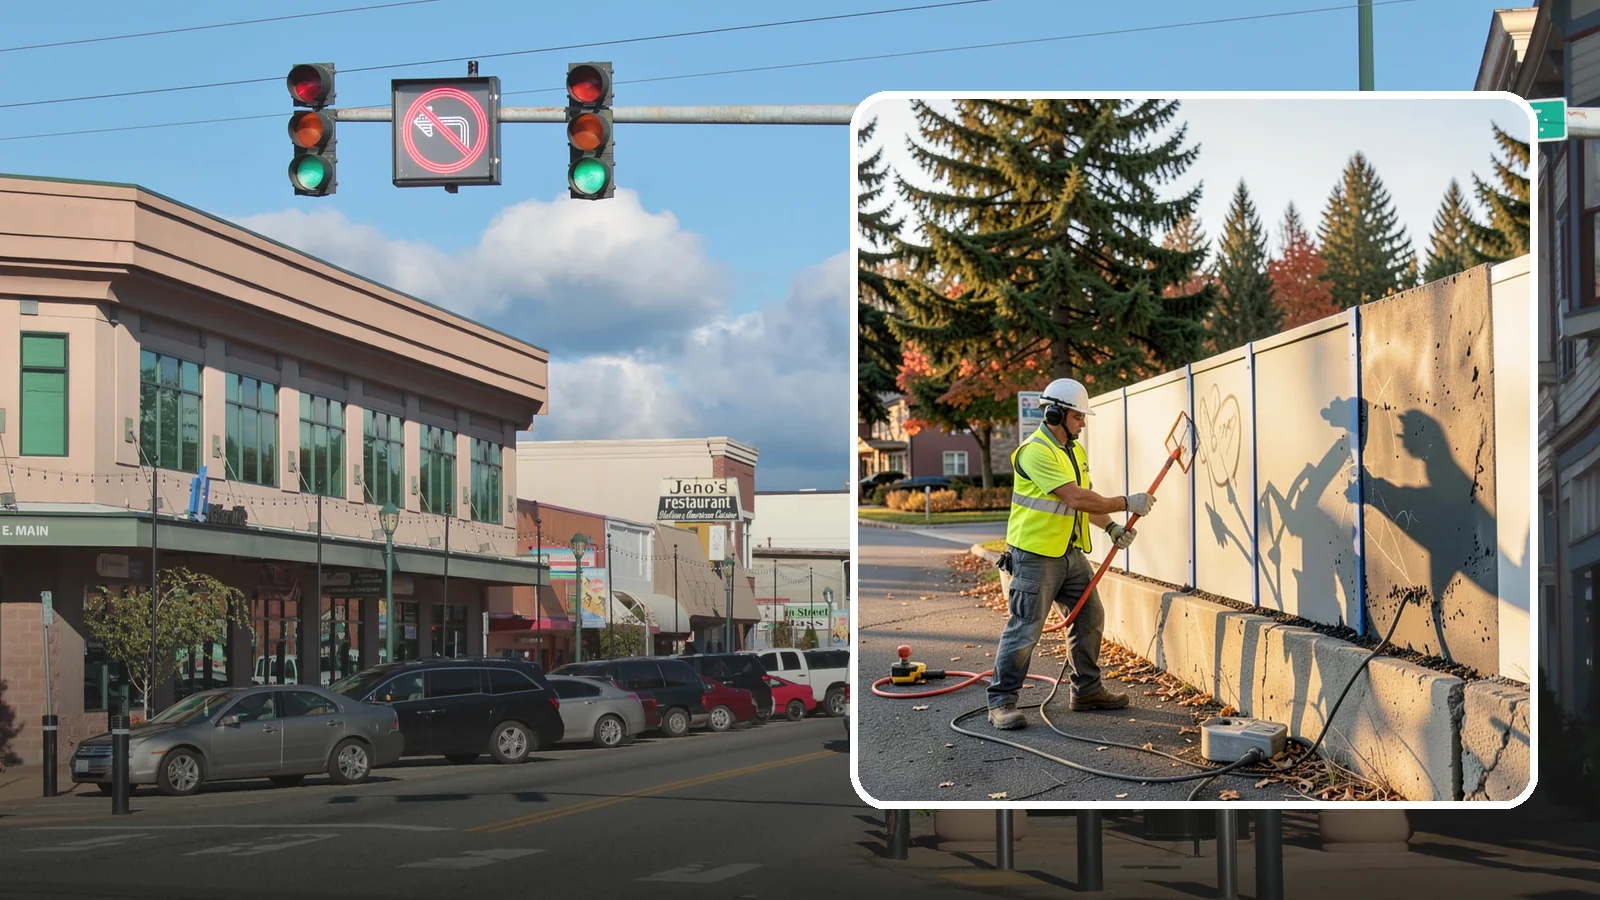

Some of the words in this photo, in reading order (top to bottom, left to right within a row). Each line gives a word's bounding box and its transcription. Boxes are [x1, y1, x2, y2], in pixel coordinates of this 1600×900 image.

[670, 480, 727, 494] Jeno's
[665, 496, 731, 509] restaurant
[659, 510, 680, 519] Italian
[686, 510, 714, 519] American
[715, 510, 737, 519] Cuisine
[2, 525, 12, 536] E.
[15, 525, 49, 536] MAIN
[797, 608, 828, 616] Street
